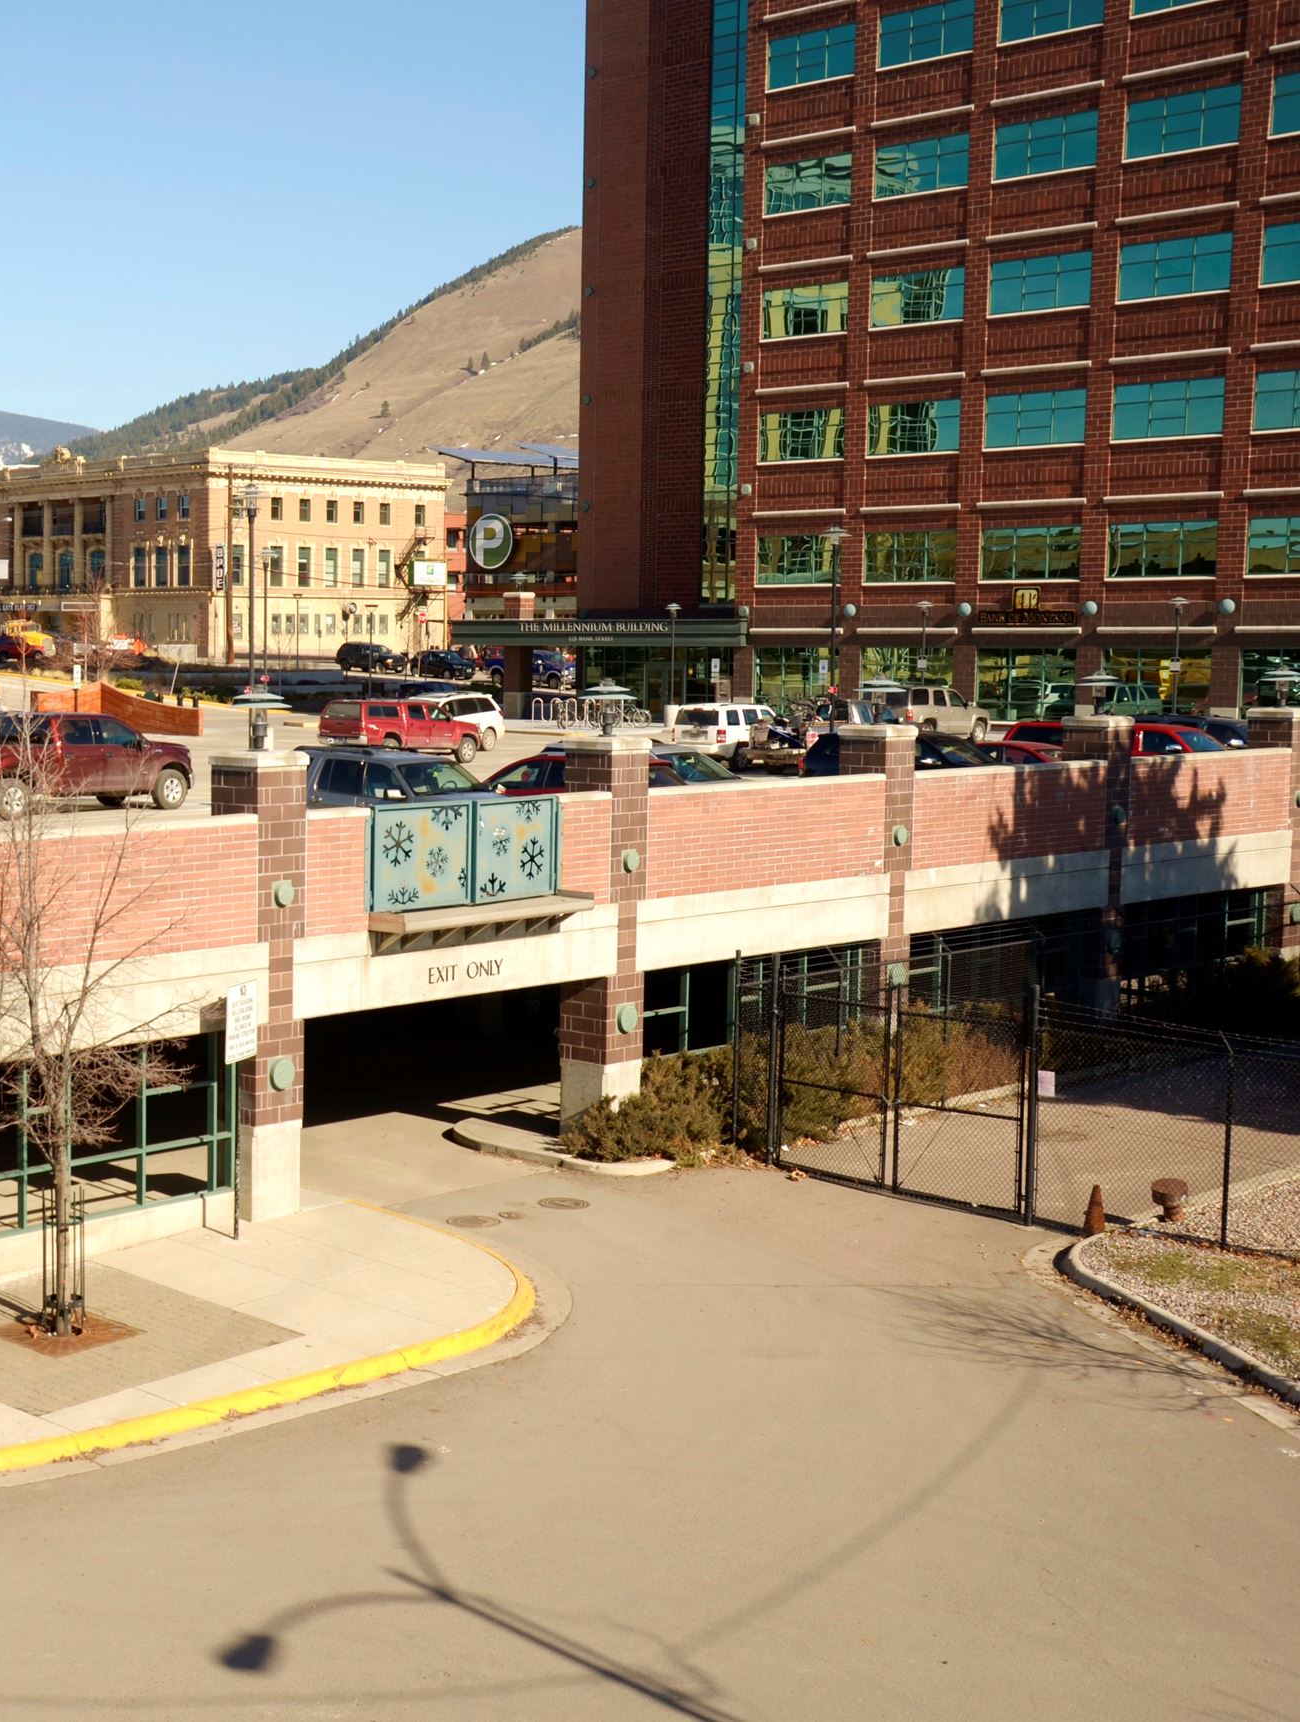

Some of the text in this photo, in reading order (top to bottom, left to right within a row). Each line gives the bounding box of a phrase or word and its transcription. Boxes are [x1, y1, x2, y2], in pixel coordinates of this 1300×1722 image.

[476, 520, 504, 565] P
[519, 622, 668, 632] THE MILLENNIUM BUILDING
[980, 613, 1004, 623] BANK
[428, 958, 503, 984] EXIT ONLY
